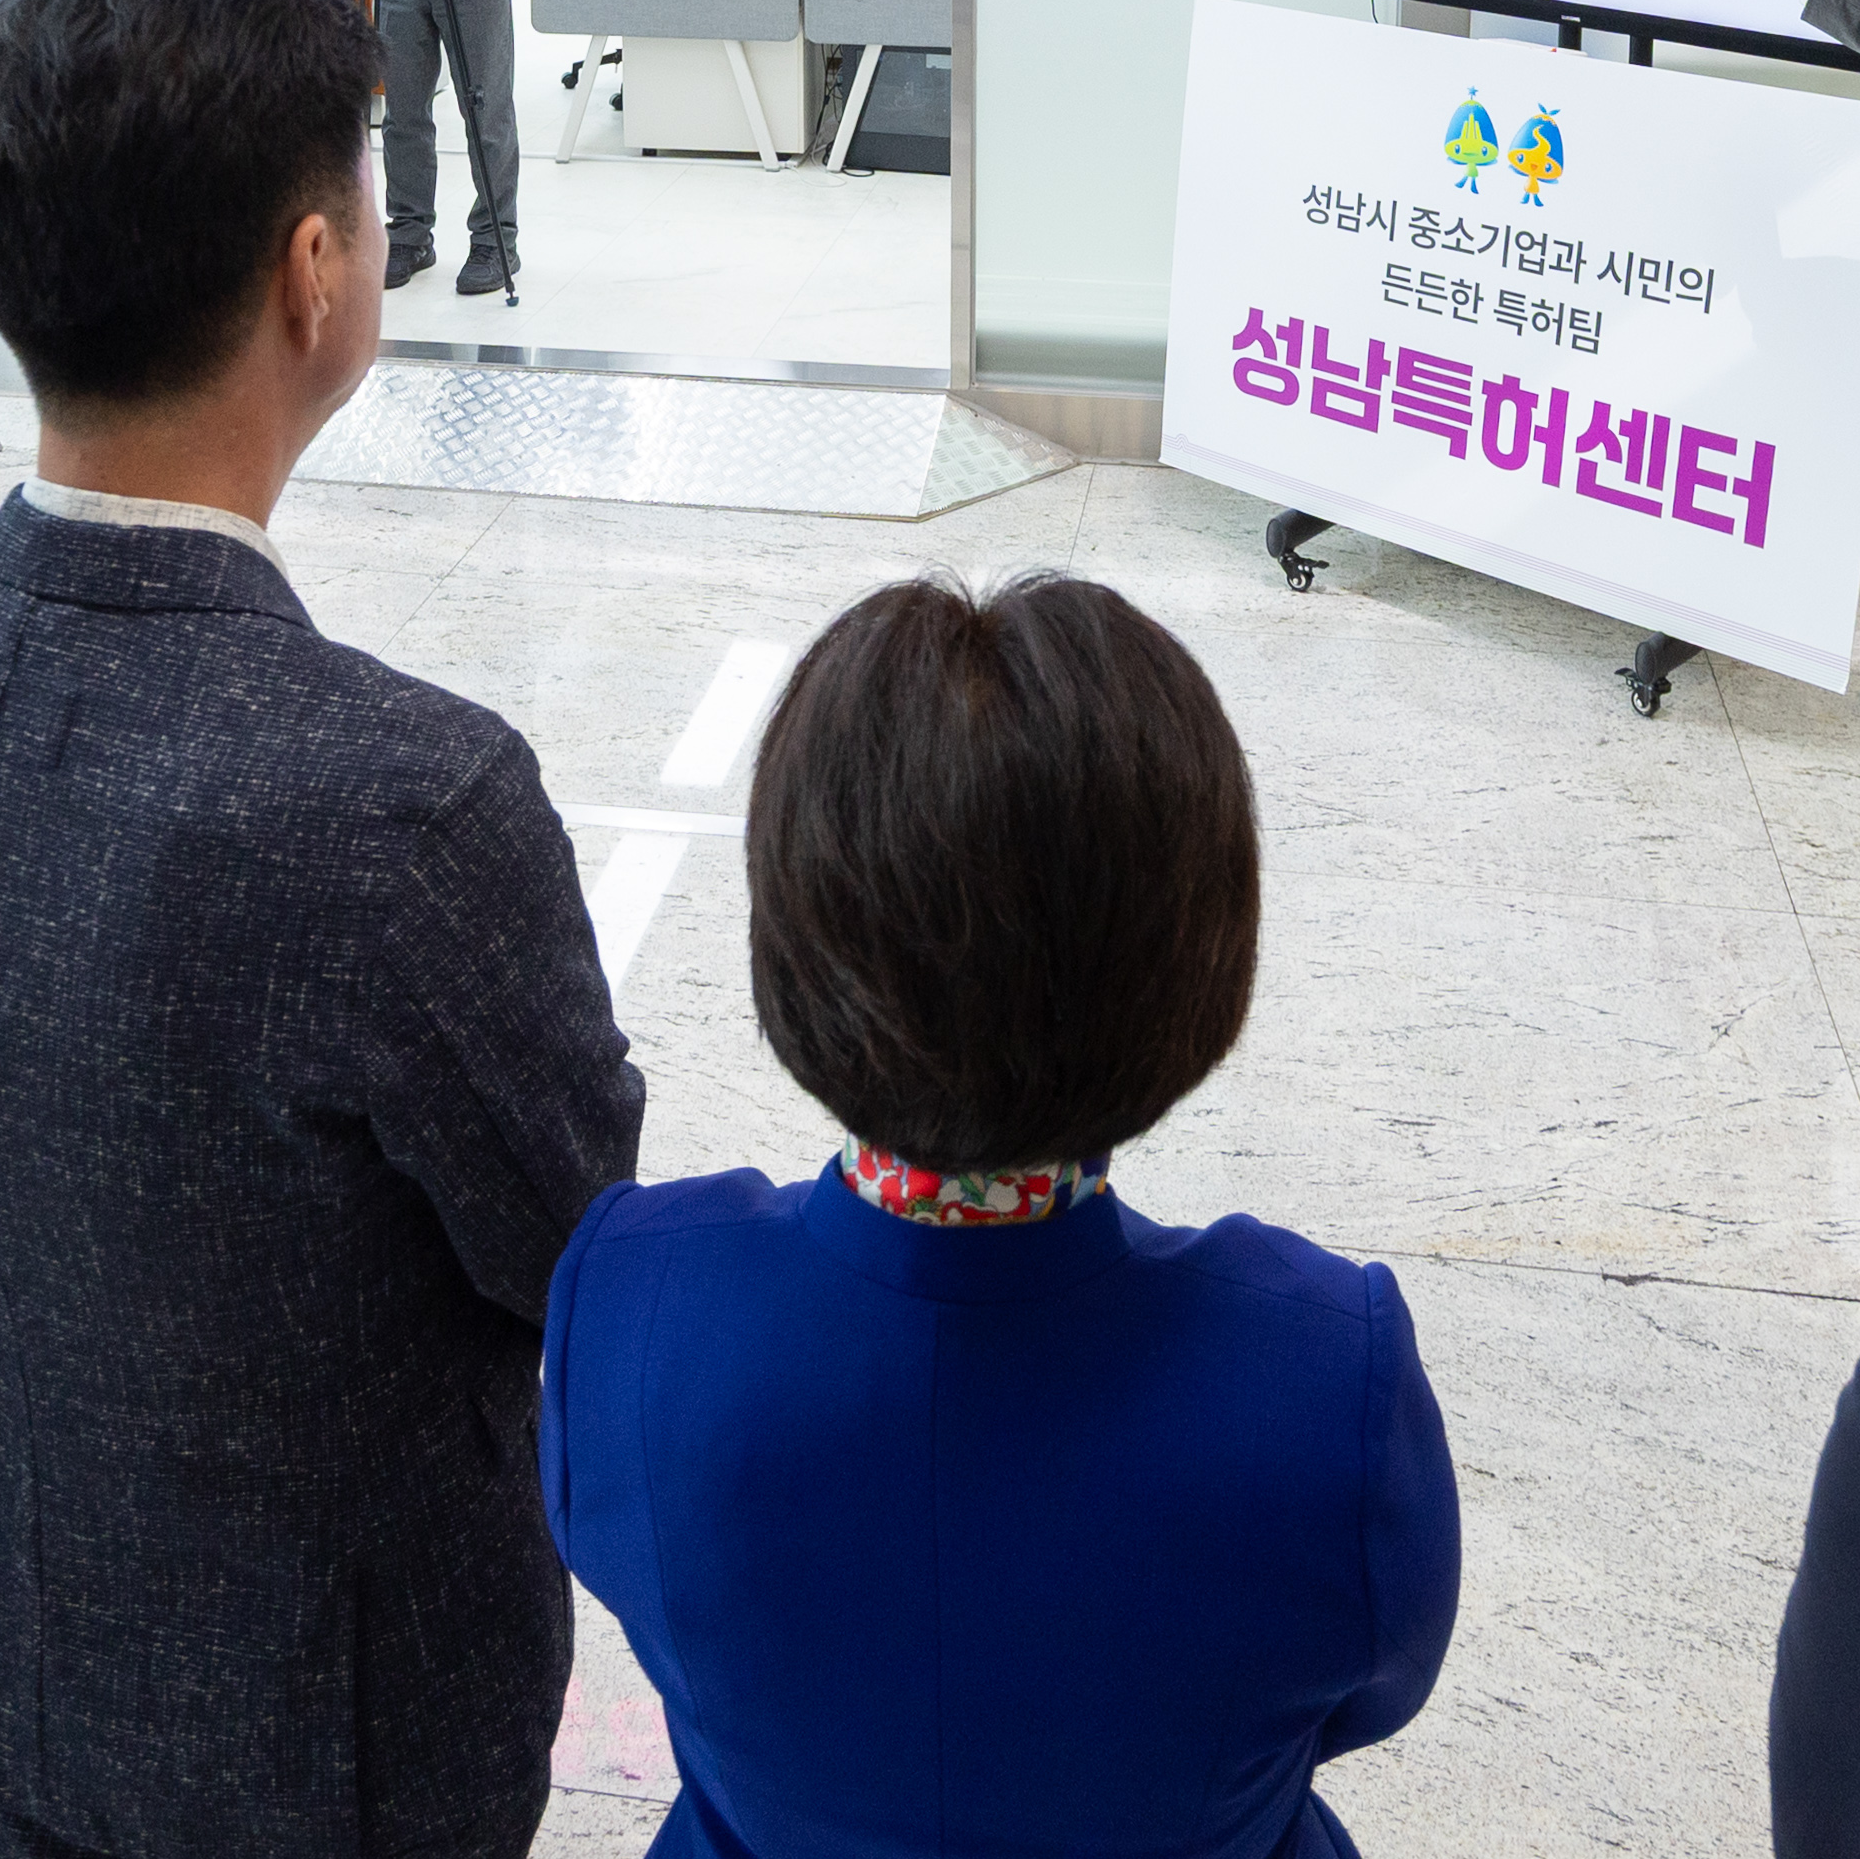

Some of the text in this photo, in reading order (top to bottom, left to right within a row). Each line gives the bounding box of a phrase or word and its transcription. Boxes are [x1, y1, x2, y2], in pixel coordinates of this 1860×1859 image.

[1302, 184, 1715, 314] 성남시 중소기업과 시민의
[1381, 262, 1603, 355] 든든한 특허팀
[1233, 306, 1777, 550] 성남특허센터
